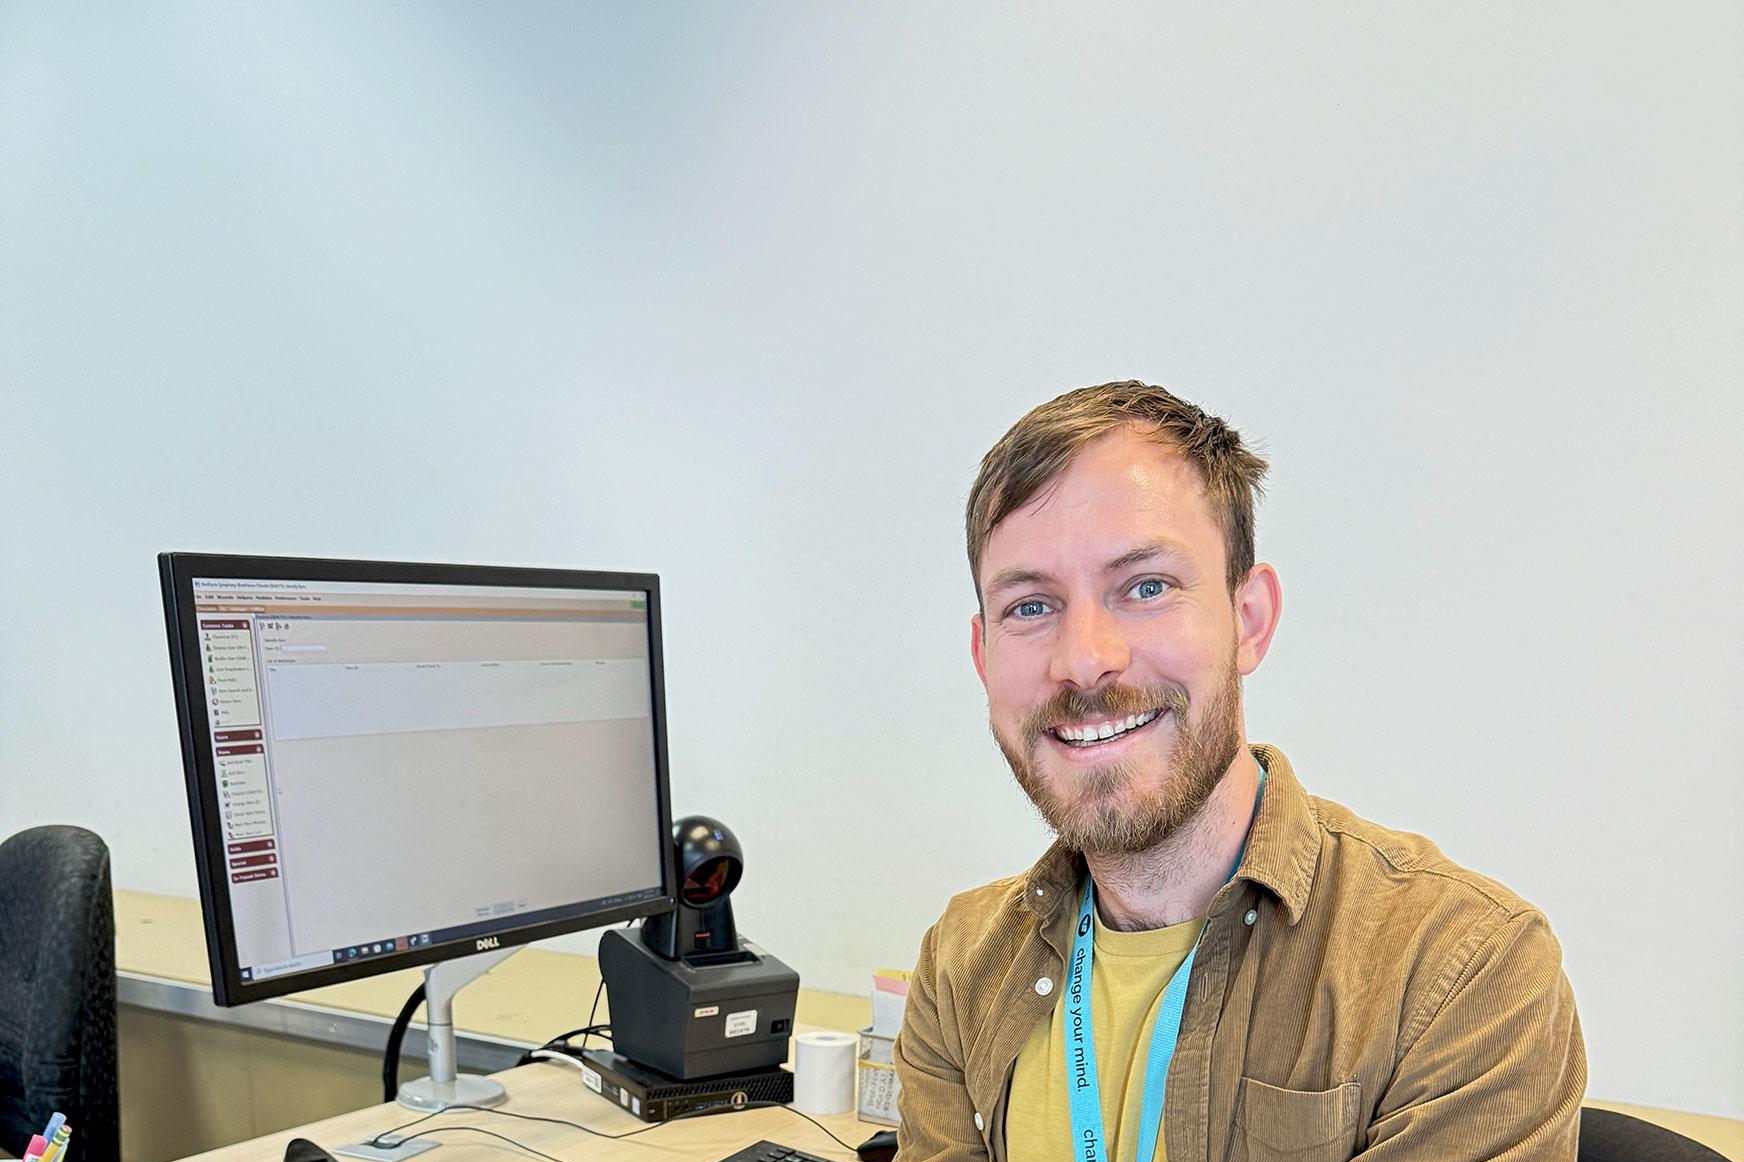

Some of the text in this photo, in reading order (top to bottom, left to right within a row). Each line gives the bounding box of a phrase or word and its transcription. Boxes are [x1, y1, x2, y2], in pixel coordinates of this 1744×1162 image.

[476, 937, 500, 953] DELL
[1069, 947, 1090, 1093] change your mind.
